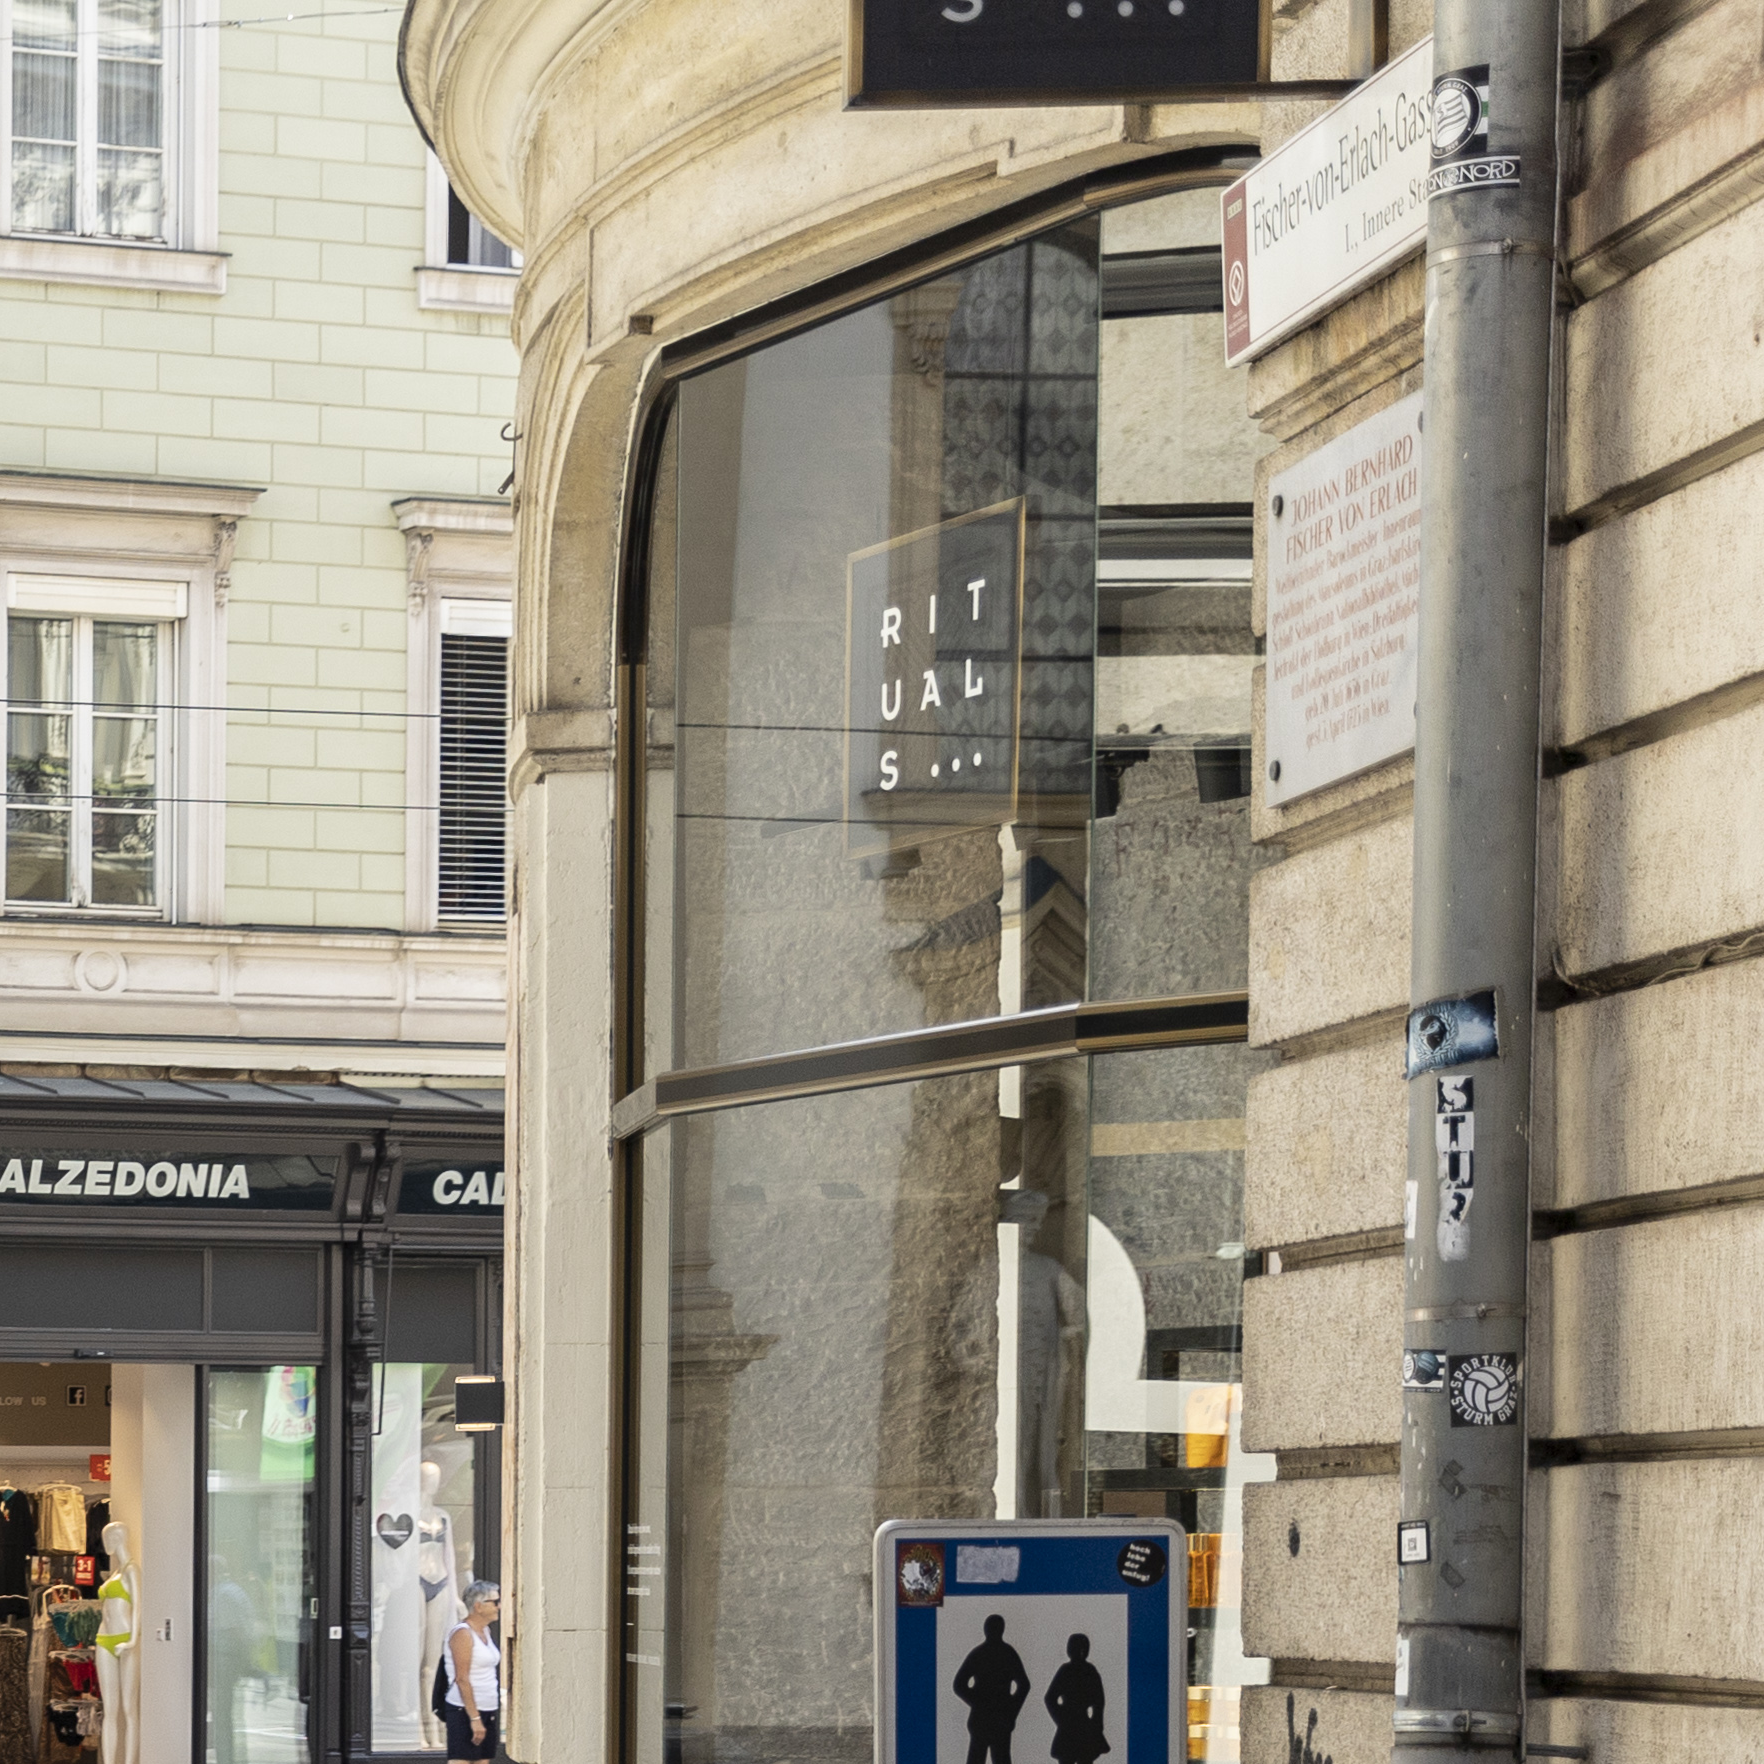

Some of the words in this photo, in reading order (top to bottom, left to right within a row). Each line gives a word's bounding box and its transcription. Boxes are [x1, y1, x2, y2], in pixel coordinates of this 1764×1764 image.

[1459, 160, 1516, 182] NORD
[1362, 199, 1404, 242] Innere
[1290, 475, 1339, 527] JOHANN
[1345, 432, 1412, 496] BERNHARD
[1286, 513, 1332, 564] FISCHER
[1338, 495, 1364, 535] VON
[1370, 466, 1416, 519] ERLACH
[31, 1396, 46, 1406] US
[1451, 1396, 1494, 1425] STURM
[1497, 1392, 1518, 1422] GRAZ
[1127, 1551, 1146, 1562] lebe
[1130, 1543, 1151, 1555] hoch
[1124, 1561, 1140, 1569] der
